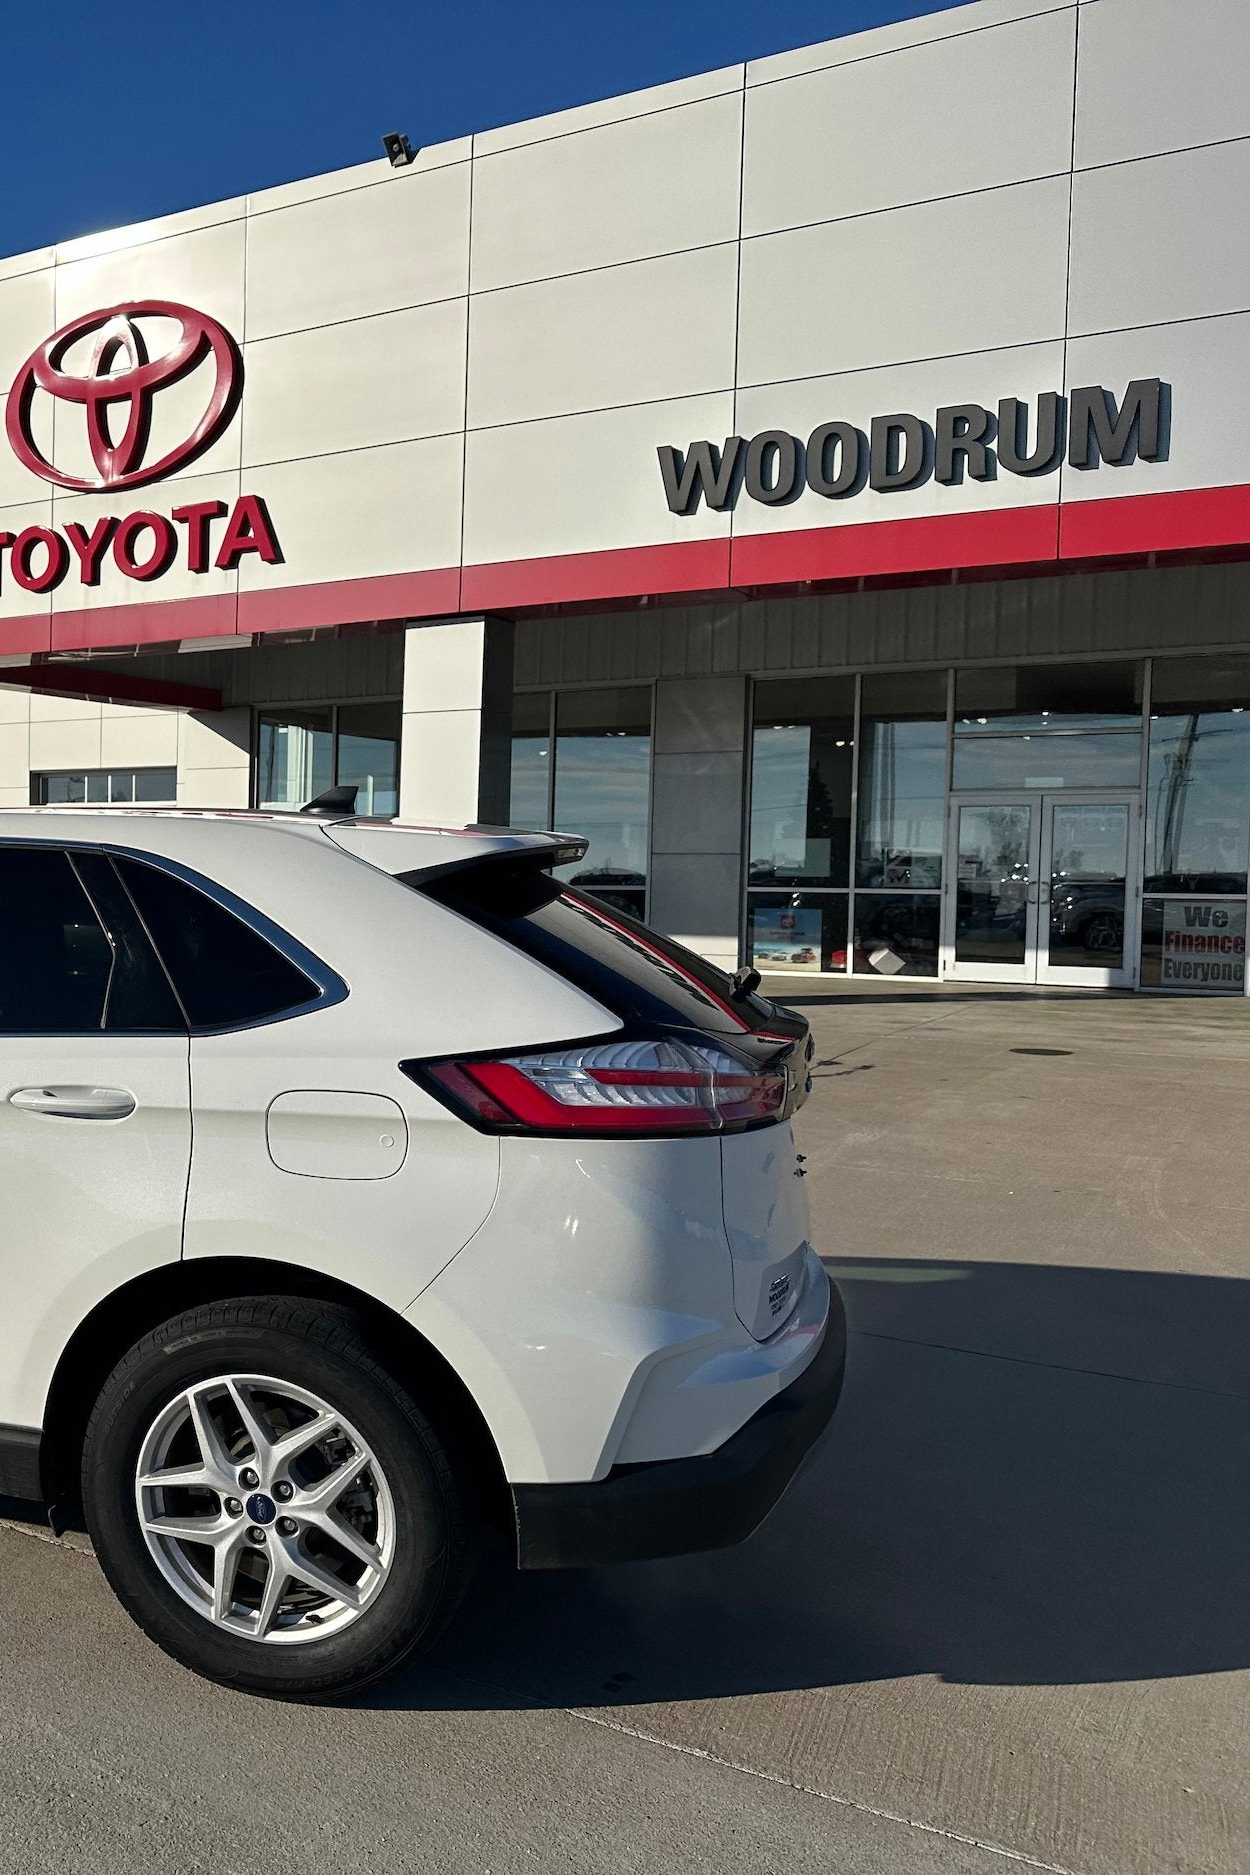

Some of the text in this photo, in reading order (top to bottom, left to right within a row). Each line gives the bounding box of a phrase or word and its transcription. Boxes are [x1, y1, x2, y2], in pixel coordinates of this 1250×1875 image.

[656, 377, 1173, 516] WOODRUM
[1184, 906, 1229, 928] We
[1165, 930, 1246, 954] Finance
[1164, 958, 1244, 982] Everyone
[104, 1381, 136, 1433] OUTSIDE
